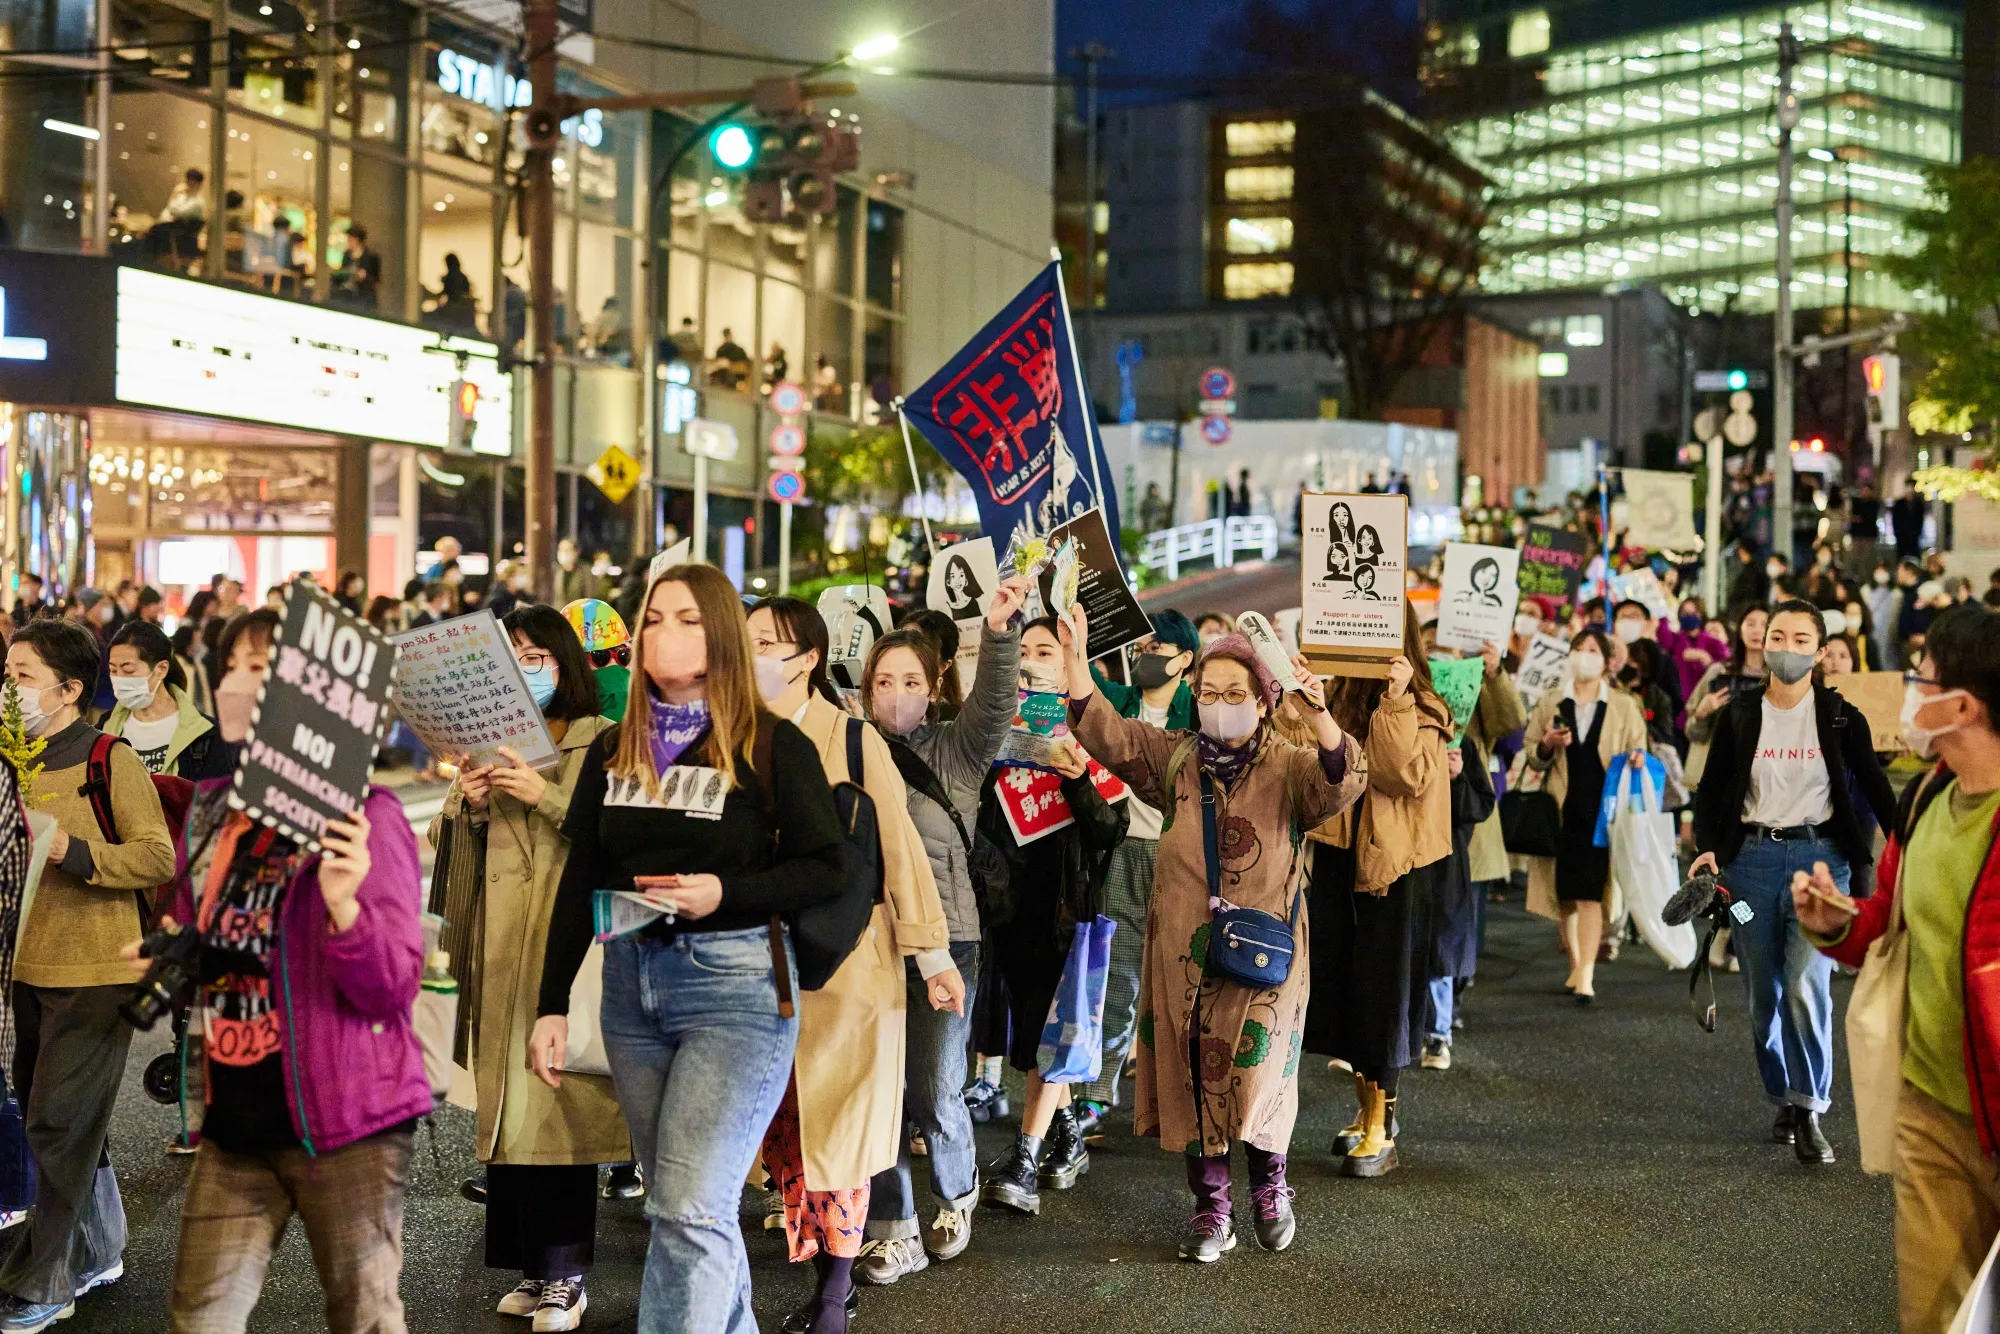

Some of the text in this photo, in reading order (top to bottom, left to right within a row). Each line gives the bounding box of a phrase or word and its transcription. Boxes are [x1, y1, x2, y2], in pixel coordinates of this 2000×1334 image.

[1323, 611, 1348, 619] #support
[1364, 612, 1383, 620] sisters
[299, 600, 378, 690] NO!
[1031, 703, 1061, 711] ウィメンズ
[292, 723, 336, 770] NO!
